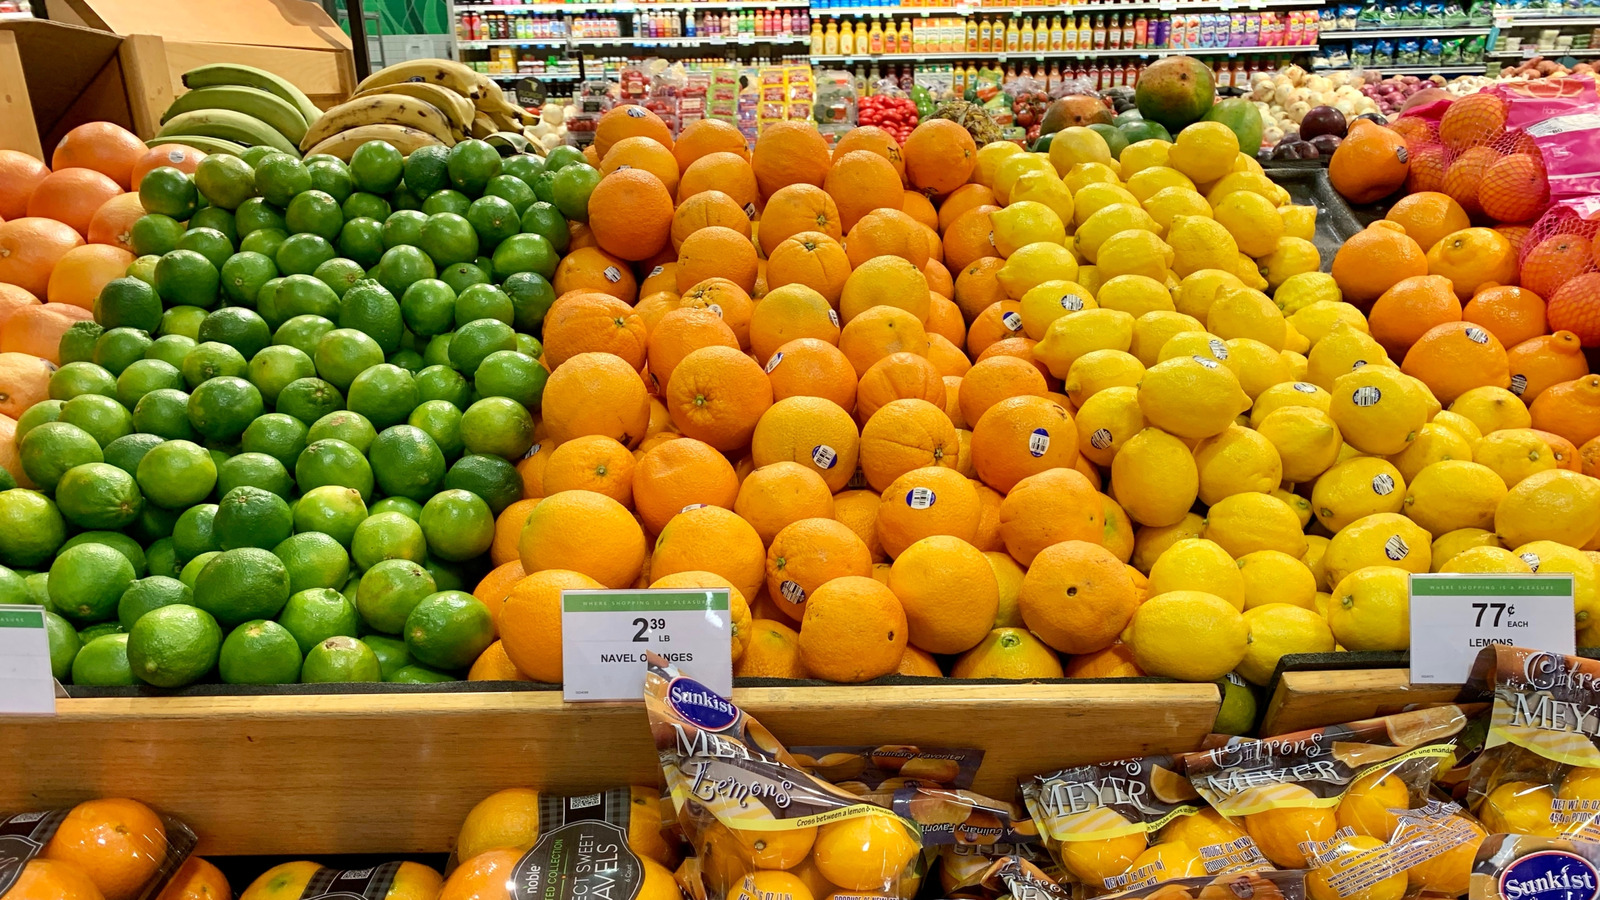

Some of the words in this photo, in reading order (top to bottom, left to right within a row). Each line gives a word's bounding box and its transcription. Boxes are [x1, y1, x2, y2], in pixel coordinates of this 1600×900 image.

[520, 96, 540, 105] LOCAL
[1469, 638, 1514, 647] LEMONS
[600, 654, 637, 663] NAVEL
[640, 653, 693, 662] OANGES
[671, 686, 734, 717] Sunkist
[1508, 692, 1600, 738] MEY
[871, 750, 916, 759] Culinary
[917, 752, 966, 761] Favorite!
[1210, 732, 1323, 769] Citrons
[1418, 748, 1431, 756] une
[690, 760, 794, 810] Lemons
[1039, 773, 1146, 818] MEYER
[1552, 799, 1566, 810] NET
[1568, 799, 1579, 810] WT
[1580, 799, 1589, 810] 16
[797, 814, 816, 827] Cross
[816, 811, 842, 826] between
[847, 806, 864, 816] lemon
[958, 824, 1003, 837] Culinary
[1007, 828, 1015, 836] A
[576, 834, 594, 872] SWEET
[1199, 844, 1225, 860] PRODUCE
[1224, 842, 1234, 853] OF
[1233, 836, 1251, 850] NEW
[1320, 842, 1328, 850] 16
[1320, 848, 1339, 864] POIDS
[548, 838, 564, 885] COLLECTION
[592, 843, 618, 900] AVELS
[624, 864, 632, 877] Count
[1204, 856, 1232, 874] PRODUIT
[524, 864, 542, 894] noble
[1104, 876, 1118, 890] NET
[1117, 872, 1129, 886] WT
[1130, 871, 1138, 882] 16
[1138, 868, 1147, 878] OZ
[1505, 864, 1597, 899] Sunkist
